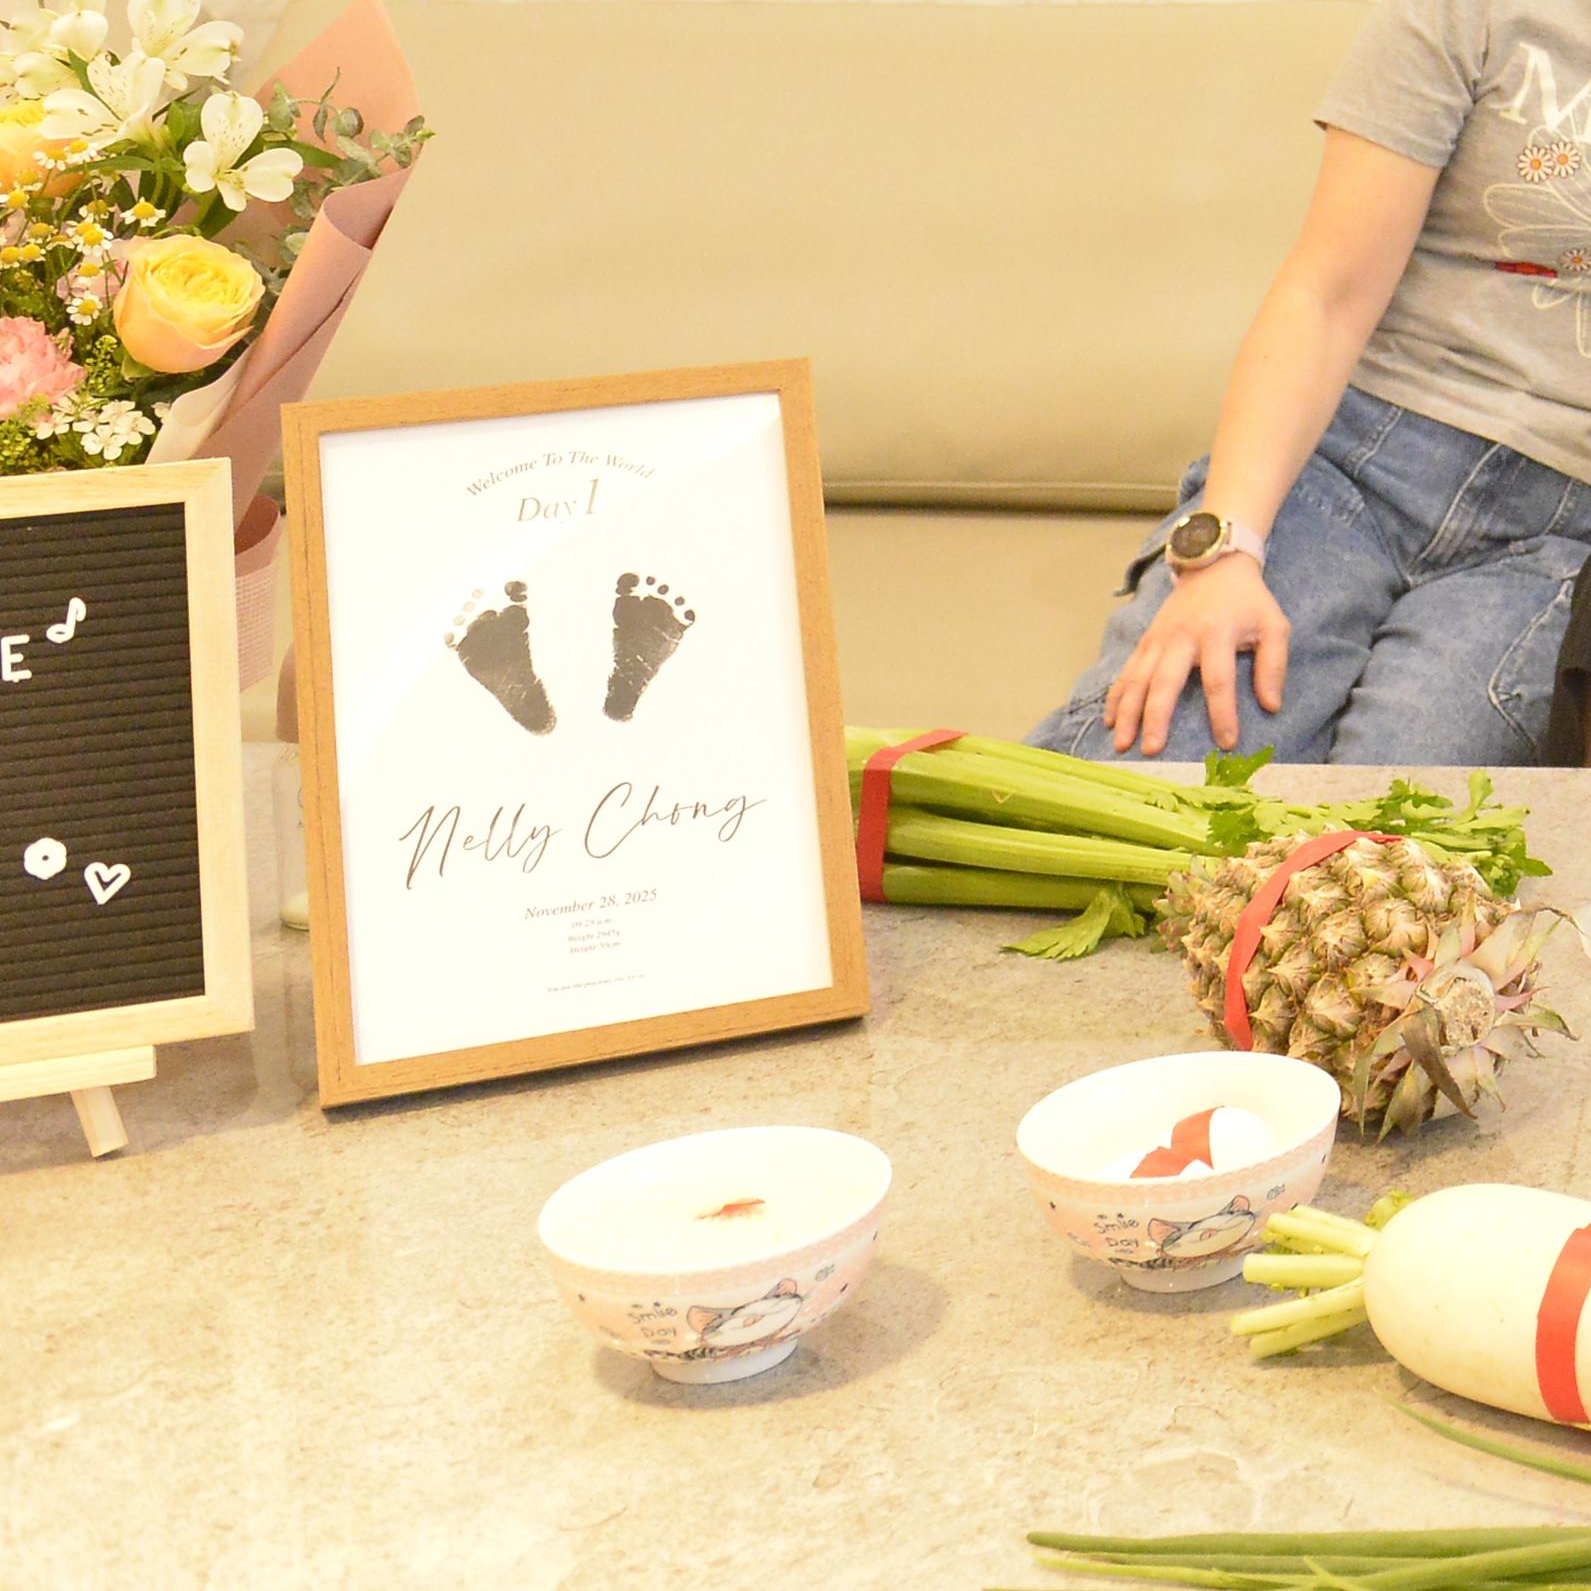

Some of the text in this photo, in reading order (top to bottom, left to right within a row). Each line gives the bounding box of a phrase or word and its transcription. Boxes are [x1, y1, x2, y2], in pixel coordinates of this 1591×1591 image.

[466, 450, 656, 498] Welcome To The World
[516, 478, 600, 524] Day 1
[399, 802, 564, 890] Nelly
[584, 781, 768, 859] Chong
[525, 889, 657, 920] November 28, 2025
[1104, 1236, 1140, 1249] Day
[642, 1326, 678, 1339] Day
